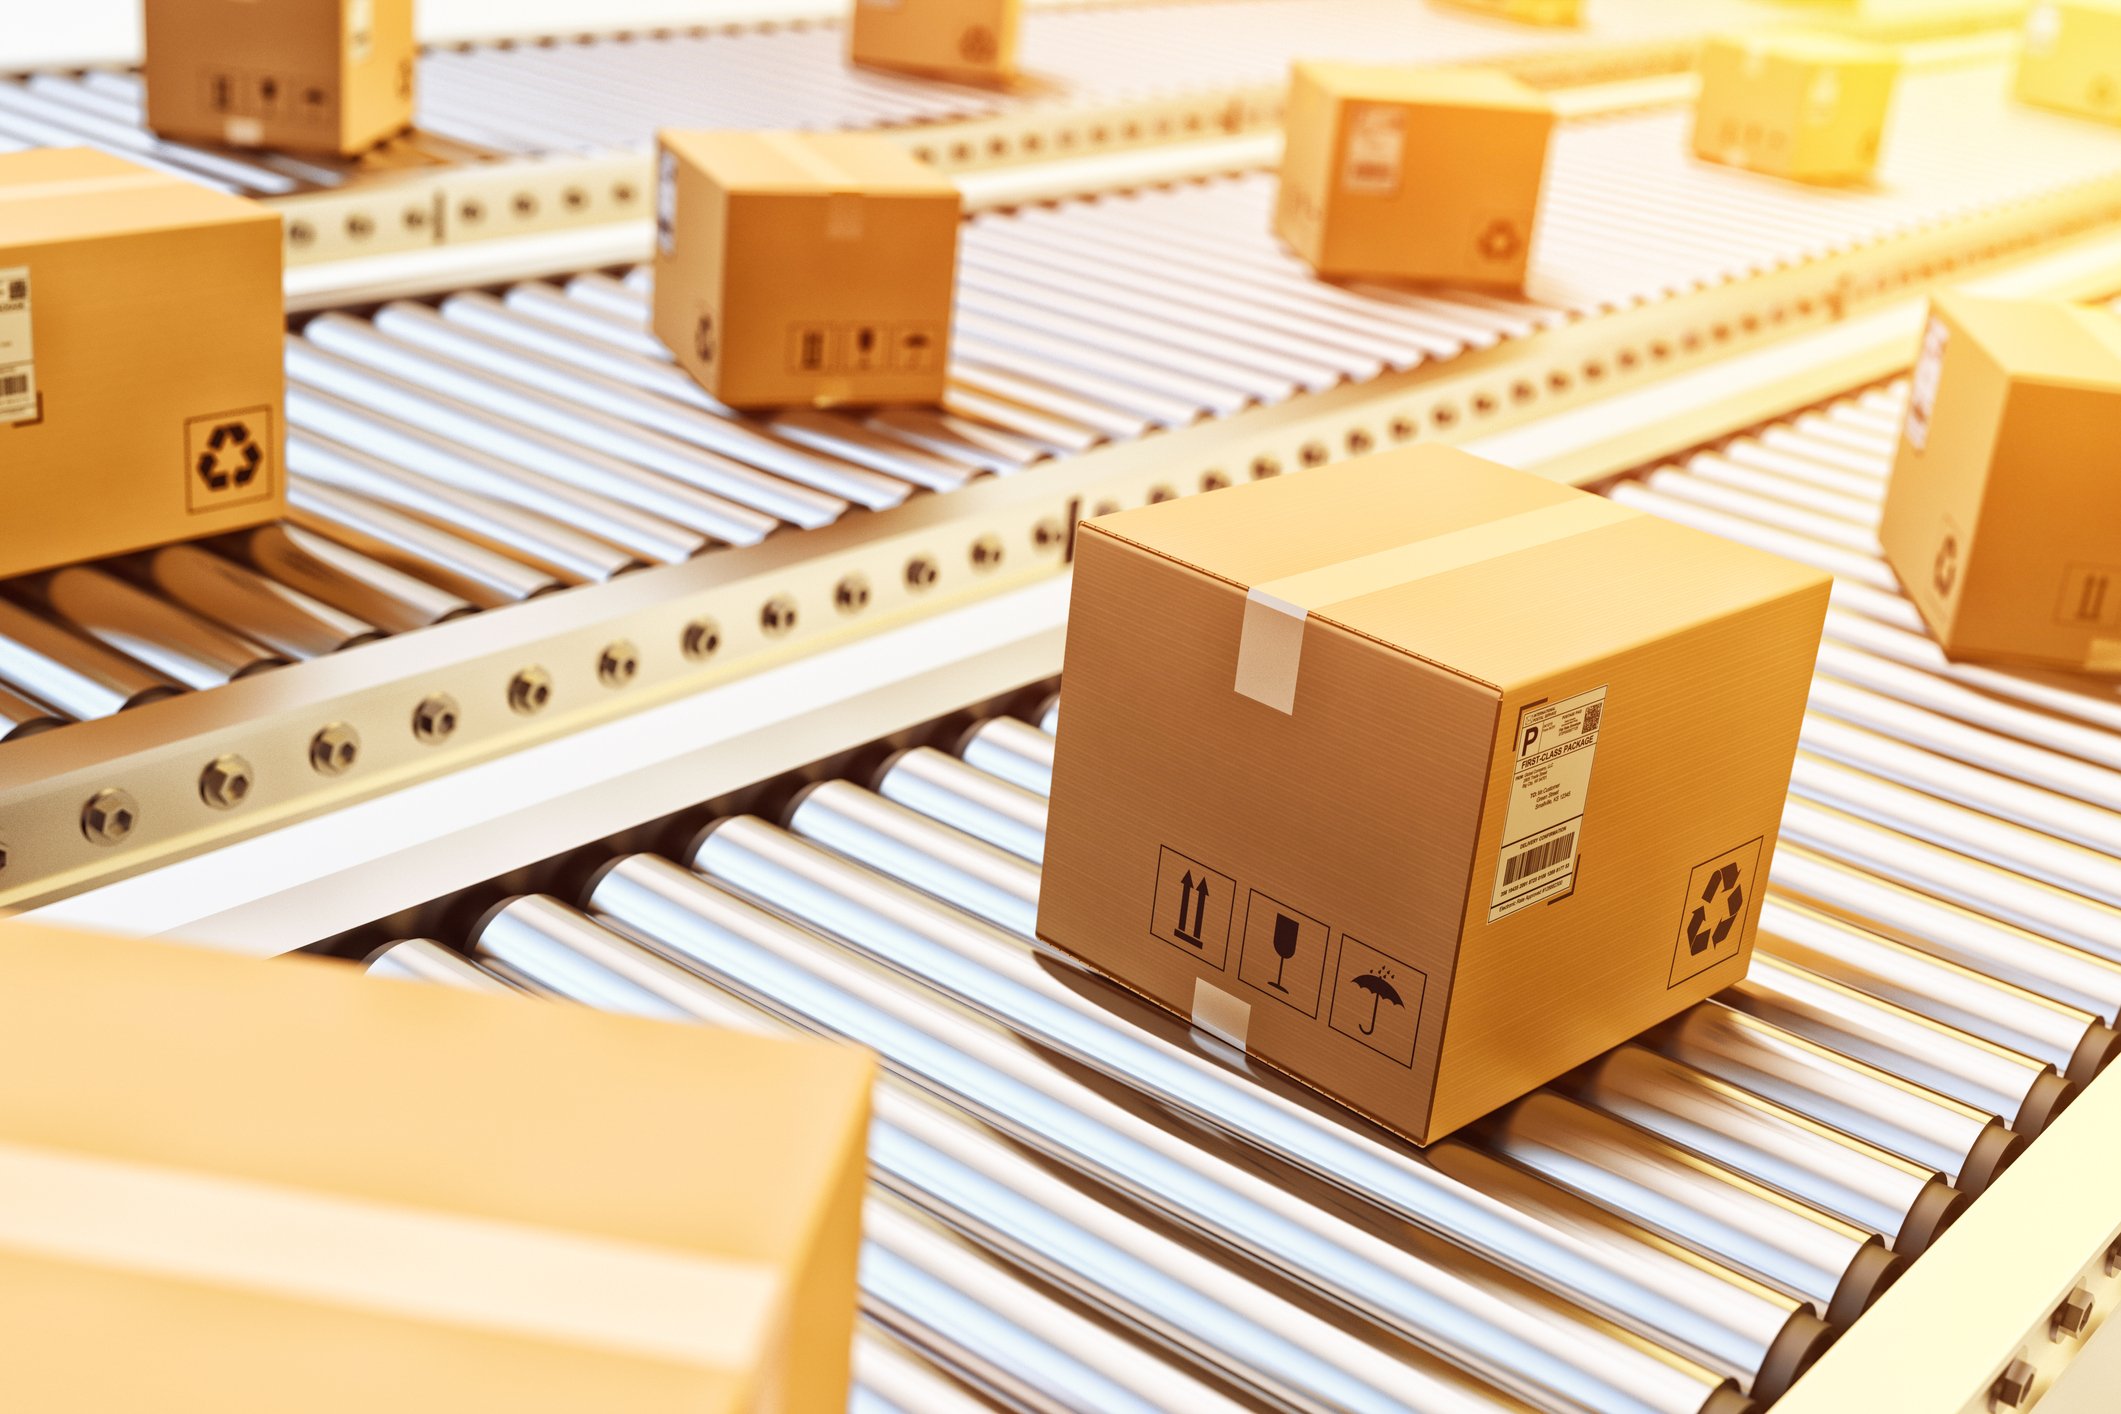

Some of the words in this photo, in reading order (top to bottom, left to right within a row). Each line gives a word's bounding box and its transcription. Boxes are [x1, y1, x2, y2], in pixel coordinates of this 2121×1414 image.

[1521, 748, 1562, 769] FIRST-CLASS
[1563, 735, 1594, 753] PACKAGE
[1522, 726, 1538, 756] P
[1536, 794, 1547, 803] Green
[1548, 789, 1559, 798] Street
[1553, 795, 1559, 803] KS
[1519, 838, 1538, 850] DELIVERY
[1539, 826, 1566, 841] CONFIRMATION
